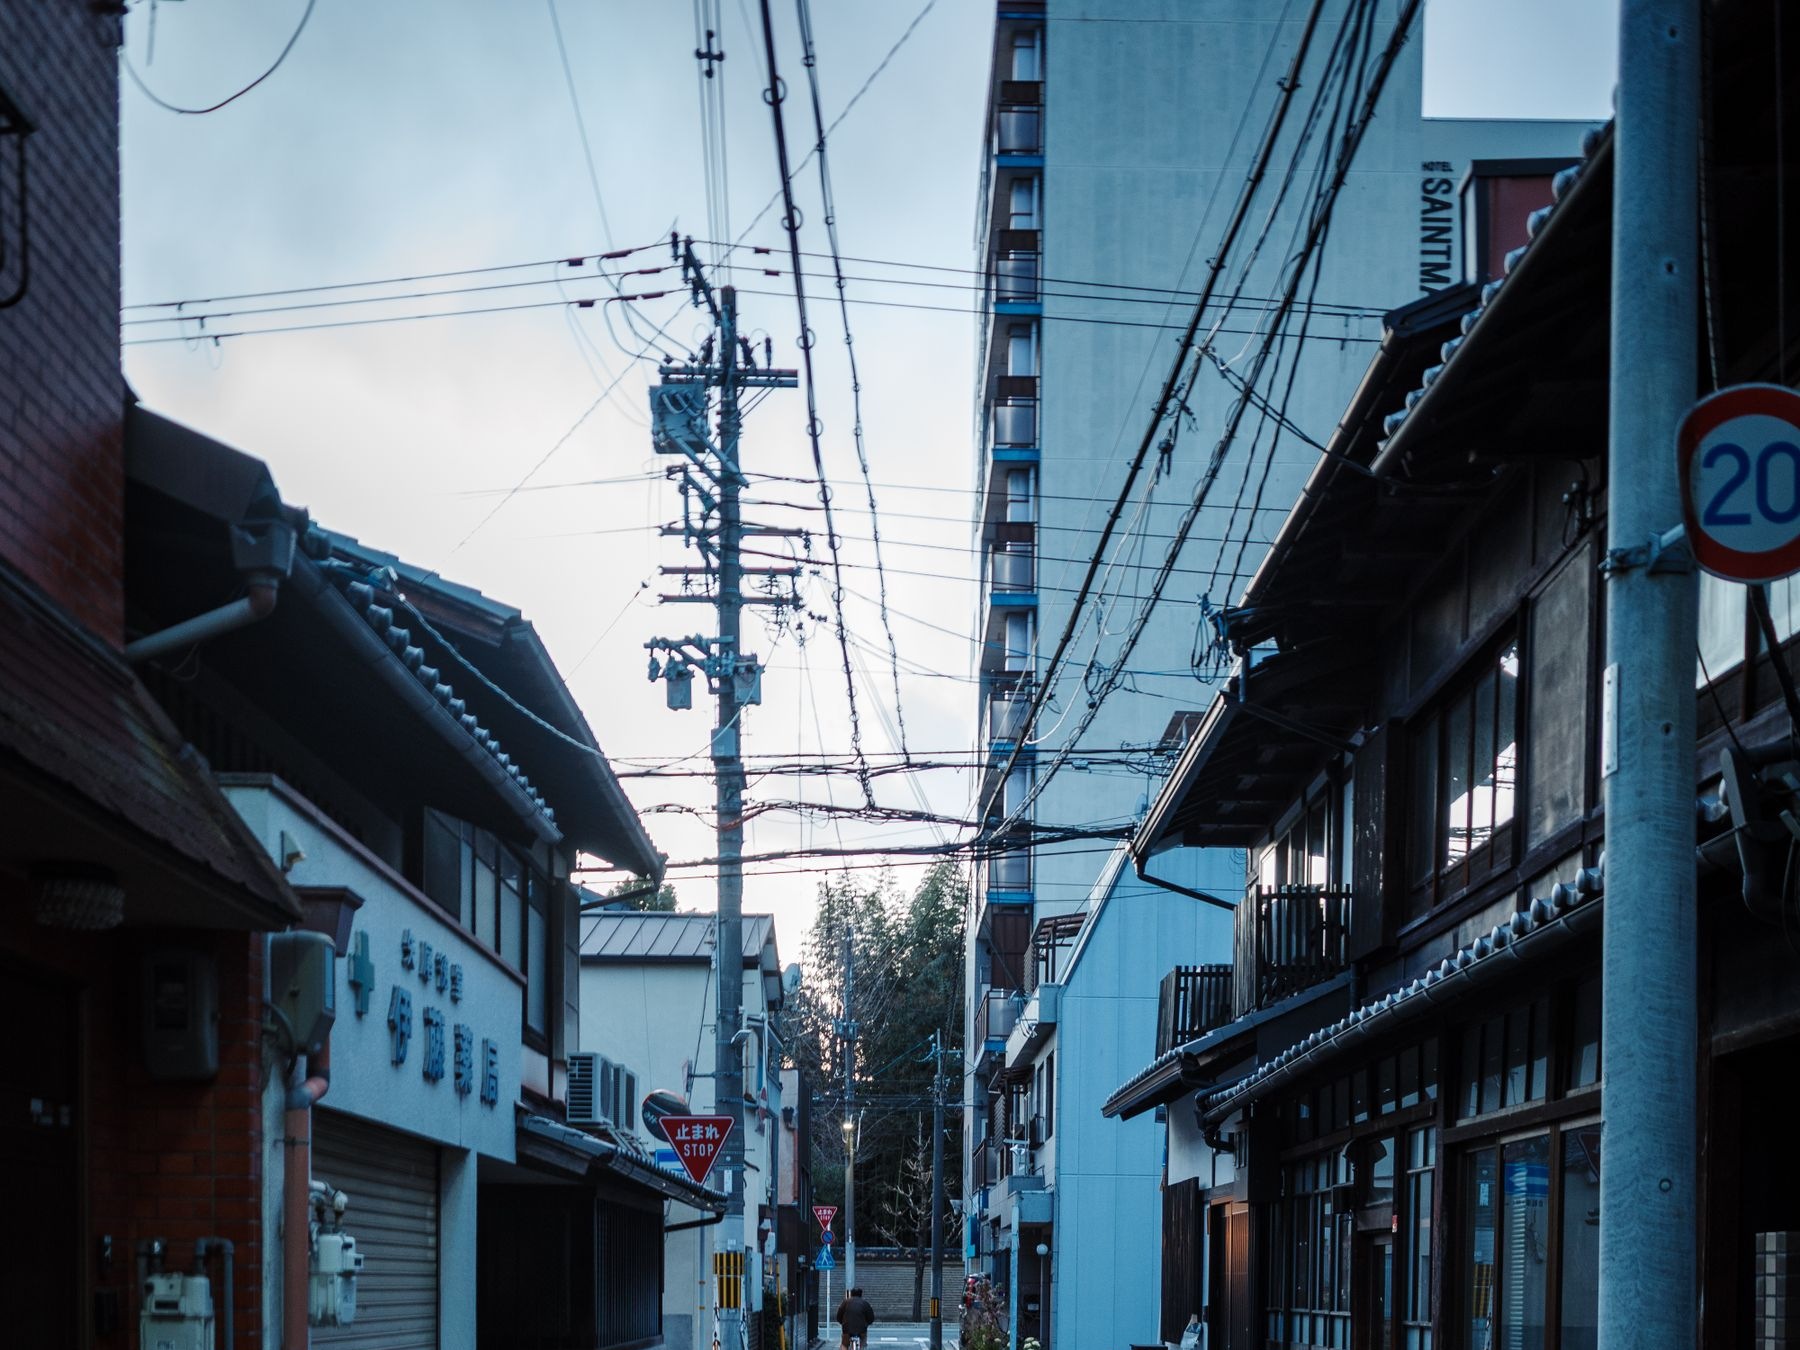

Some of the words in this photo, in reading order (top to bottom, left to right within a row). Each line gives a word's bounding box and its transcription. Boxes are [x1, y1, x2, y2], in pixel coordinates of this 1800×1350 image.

[1703, 442, 1800, 525] 20
[387, 985, 499, 1107] 伊藤薬局
[675, 1123, 720, 1140] 止まれ
[684, 1143, 714, 1157] STOP
